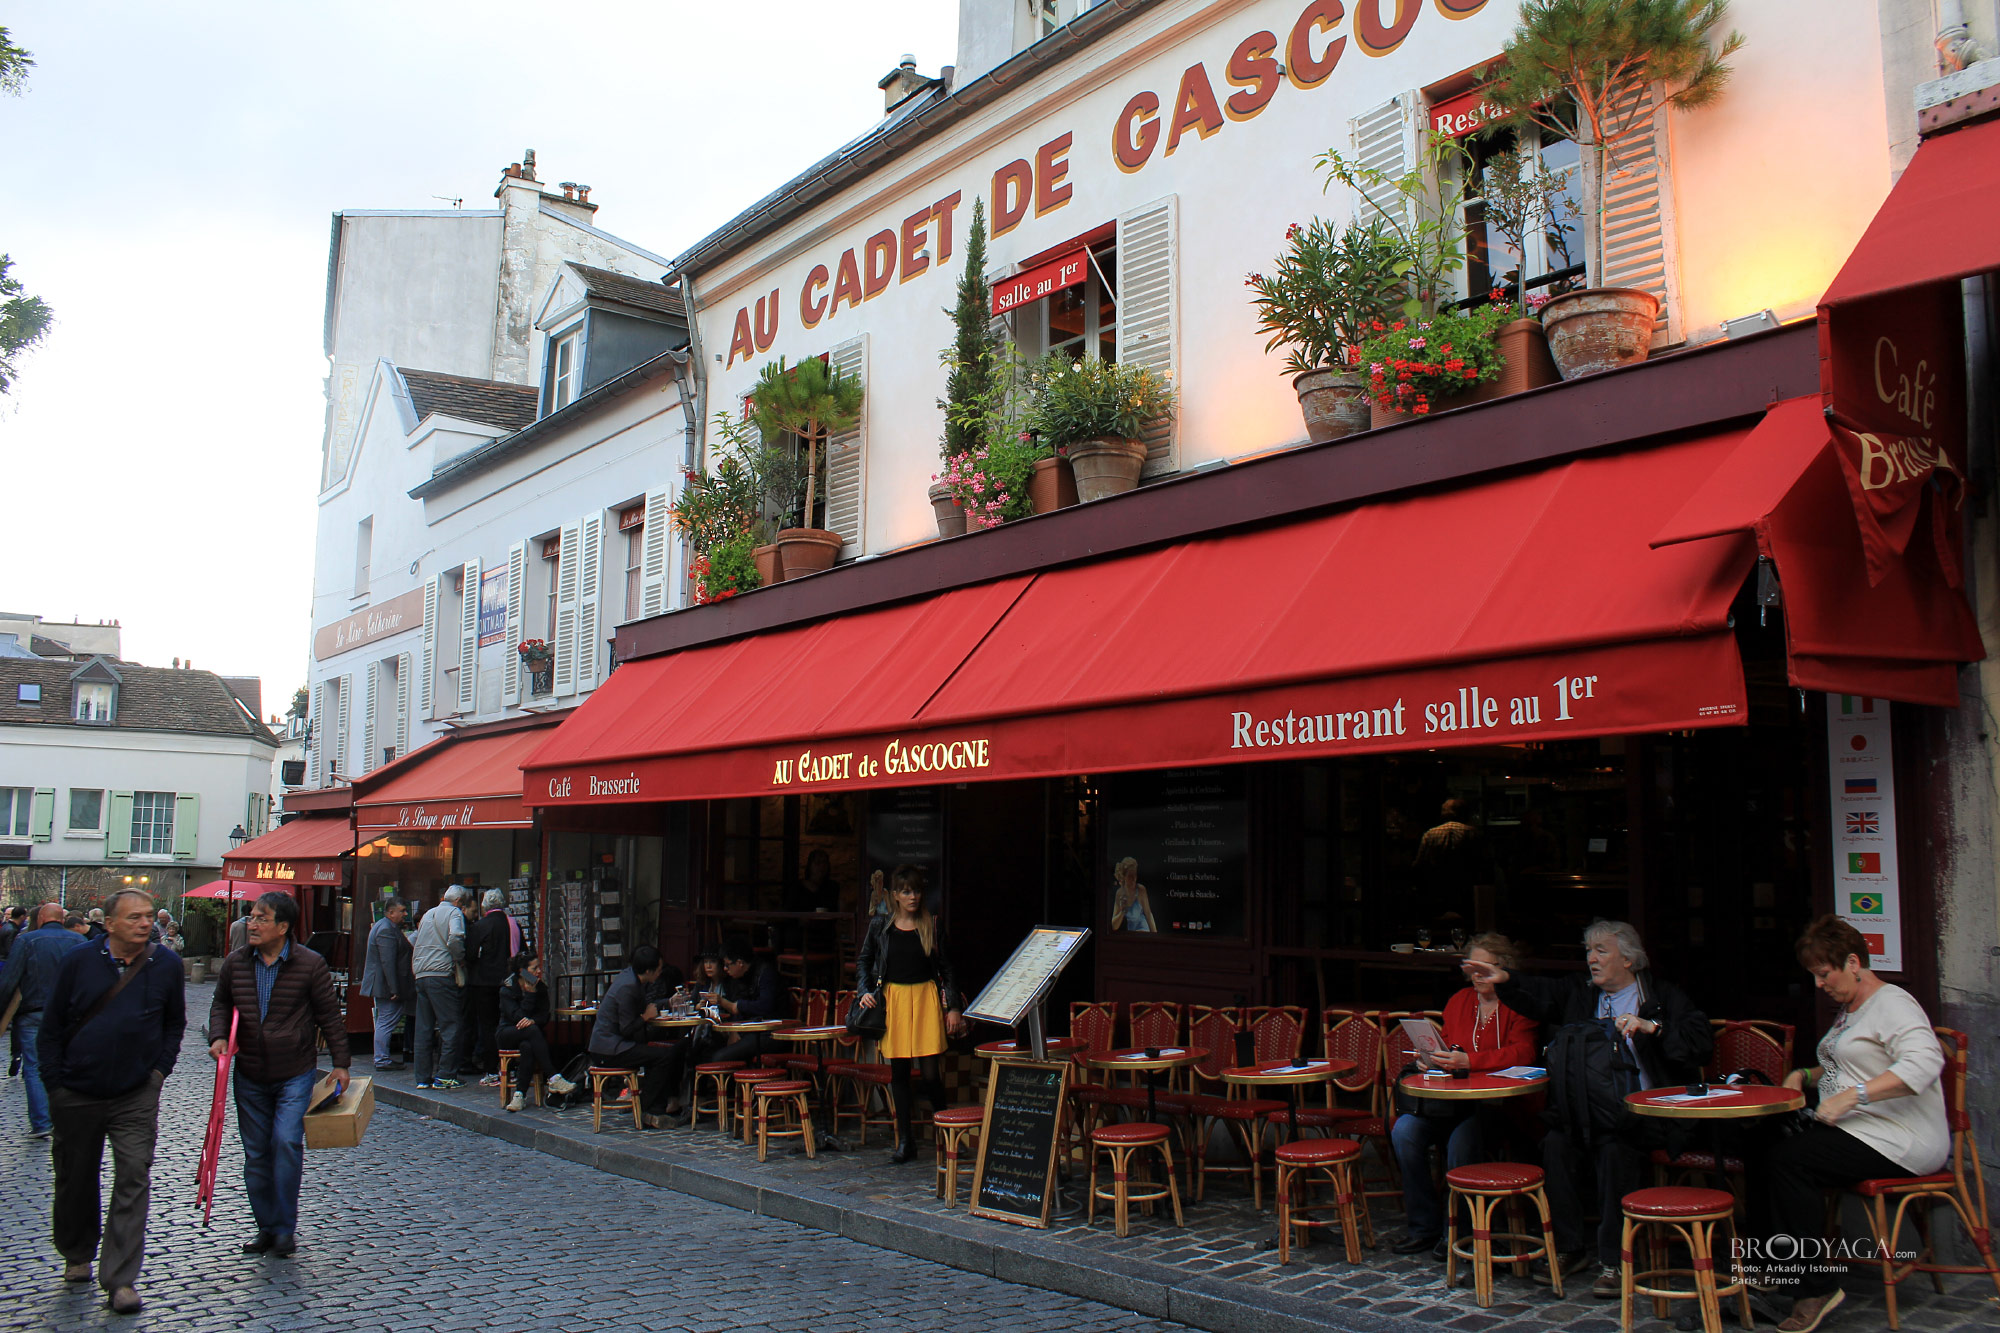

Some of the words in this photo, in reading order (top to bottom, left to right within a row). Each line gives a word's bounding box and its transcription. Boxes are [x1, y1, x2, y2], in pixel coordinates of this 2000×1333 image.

[726, 288, 780, 371] AU
[799, 189, 961, 330] CADET
[991, 130, 1074, 241] DE
[1112, 0, 1488, 174] GASCO
[998, 283, 1031, 310] salle
[1036, 278, 1053, 296] au
[1059, 261, 1079, 287] 1er
[1874, 336, 1936, 430] Café
[335, 624, 345, 649] La
[367, 609, 403, 637] Catherine
[1230, 697, 1407, 749] Restaurant
[1424, 685, 1499, 734] salle
[1510, 695, 1542, 727] au
[1553, 674, 1599, 722] 1er
[548, 776, 572, 798] Café
[589, 771, 640, 796] Brasserie
[772, 759, 794, 785] AU
[798, 750, 853, 783] CADET
[858, 754, 879, 778] de
[884, 738, 990, 775] GASCOGNE
[398, 807, 410, 827] Le
[440, 808, 459, 830] qui
[460, 804, 474, 826] lit
